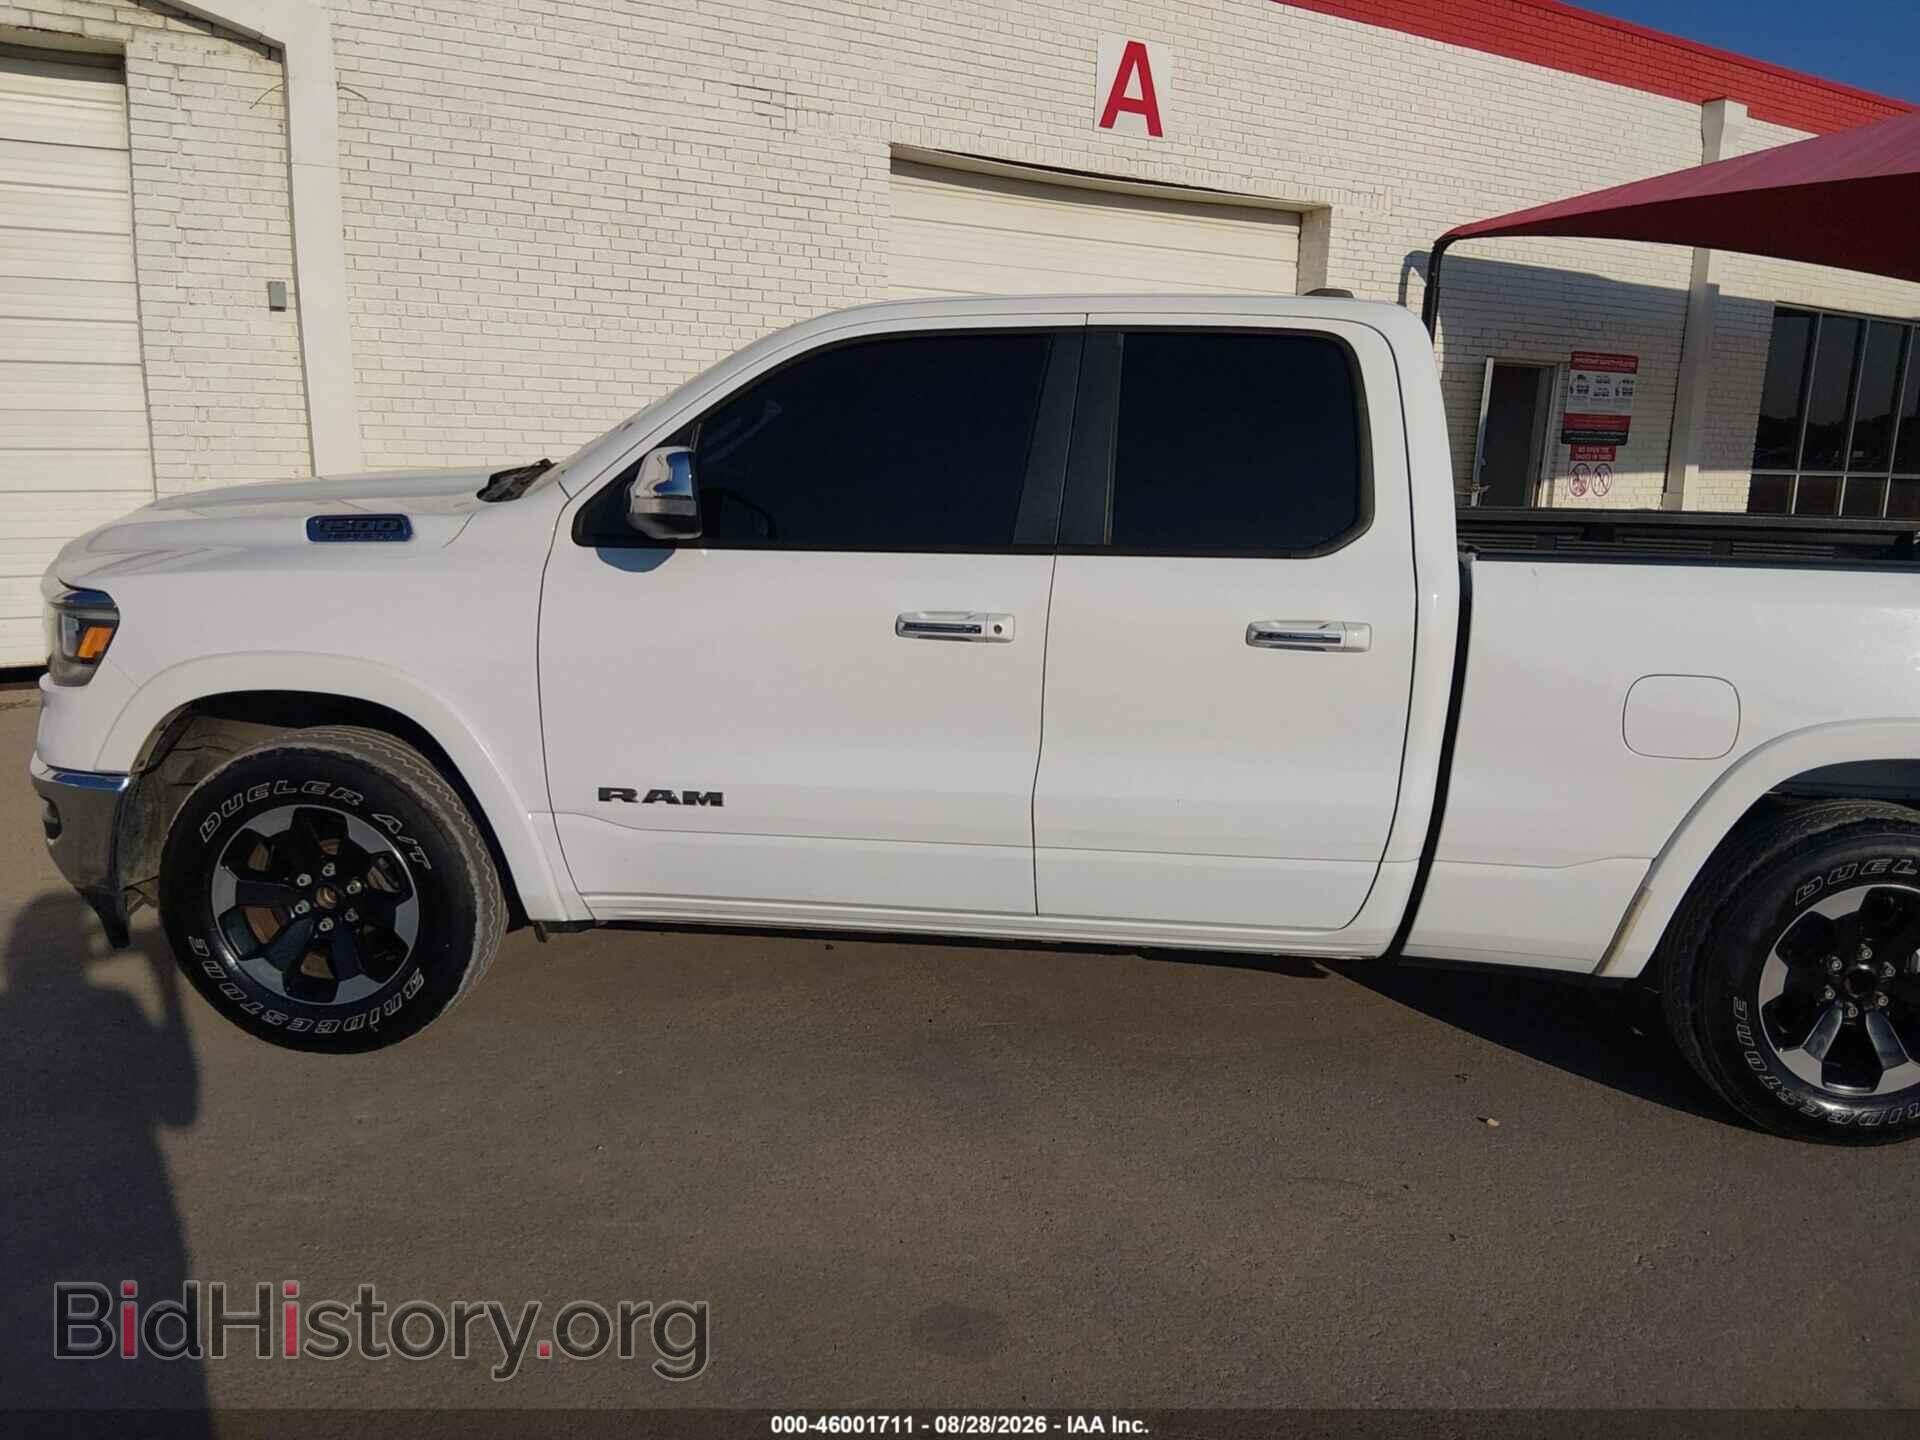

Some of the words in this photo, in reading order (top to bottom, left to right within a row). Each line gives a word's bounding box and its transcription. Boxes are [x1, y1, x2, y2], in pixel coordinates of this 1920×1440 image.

[1098, 40, 1163, 137] A
[200, 780, 364, 843] DUELER
[371, 812, 432, 871] A/T
[598, 787, 723, 807] RAM
[188, 935, 425, 1034] BRIDGESTONE
